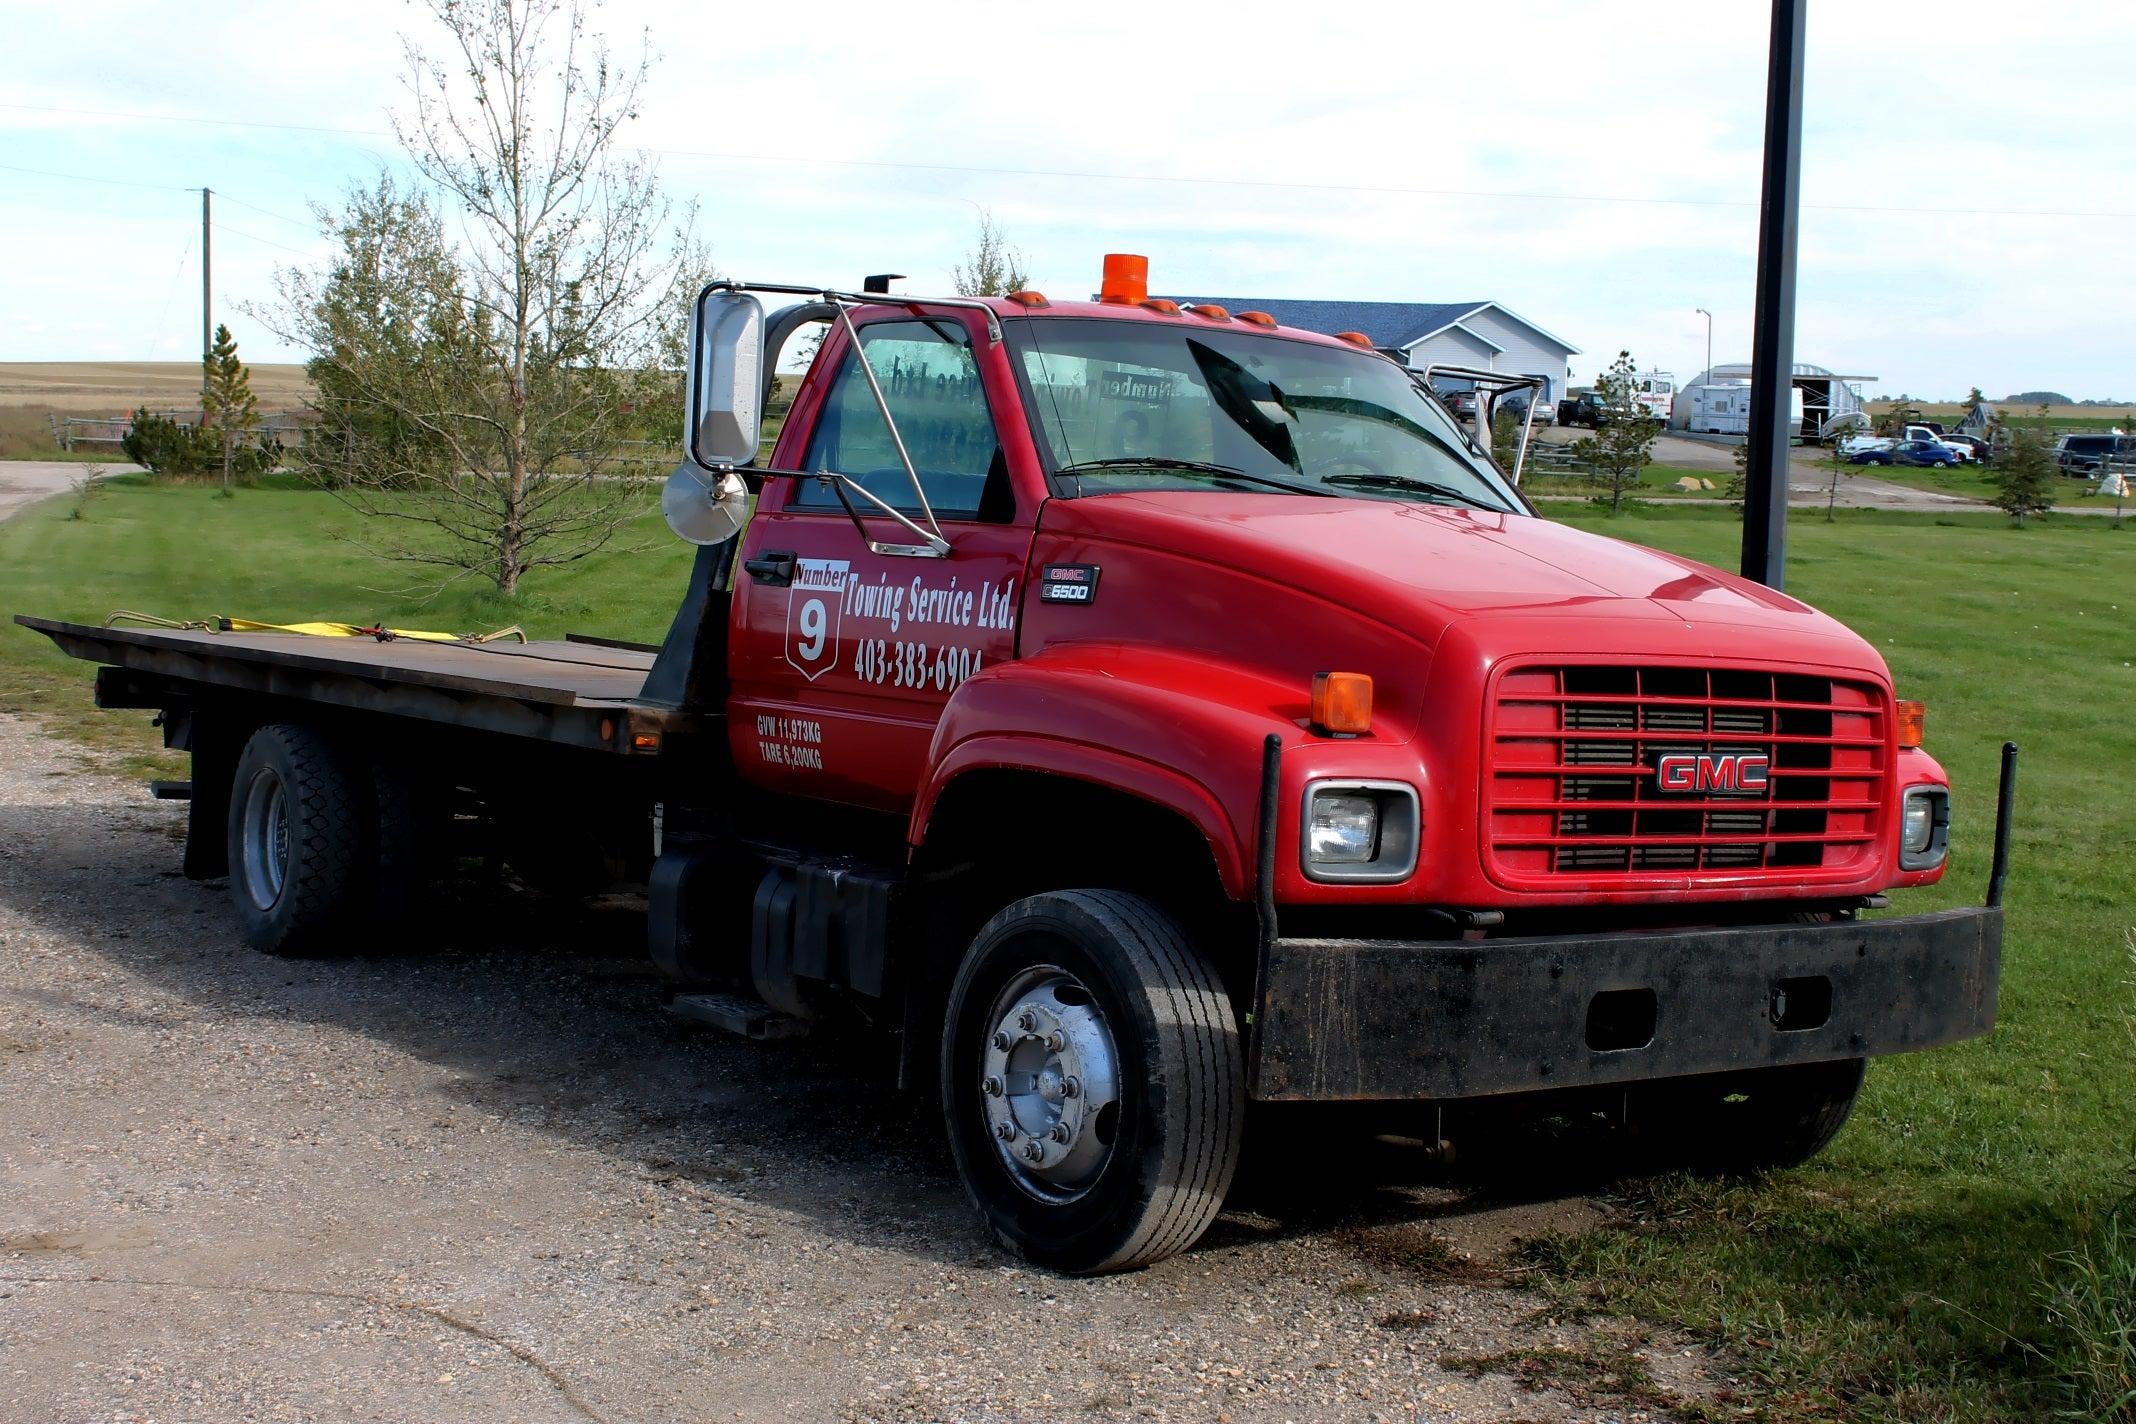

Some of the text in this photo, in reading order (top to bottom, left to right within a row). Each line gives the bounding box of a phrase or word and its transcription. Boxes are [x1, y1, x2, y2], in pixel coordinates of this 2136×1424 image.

[794, 563, 848, 588] Number
[1051, 568, 1084, 581] GMC
[845, 571, 1015, 633] Towing Service Ltd.
[799, 598, 827, 661] 9
[757, 714, 822, 744] GVW 11,973KG
[759, 741, 823, 770] TARE 6,200KG
[1660, 755, 1768, 791] GMC
